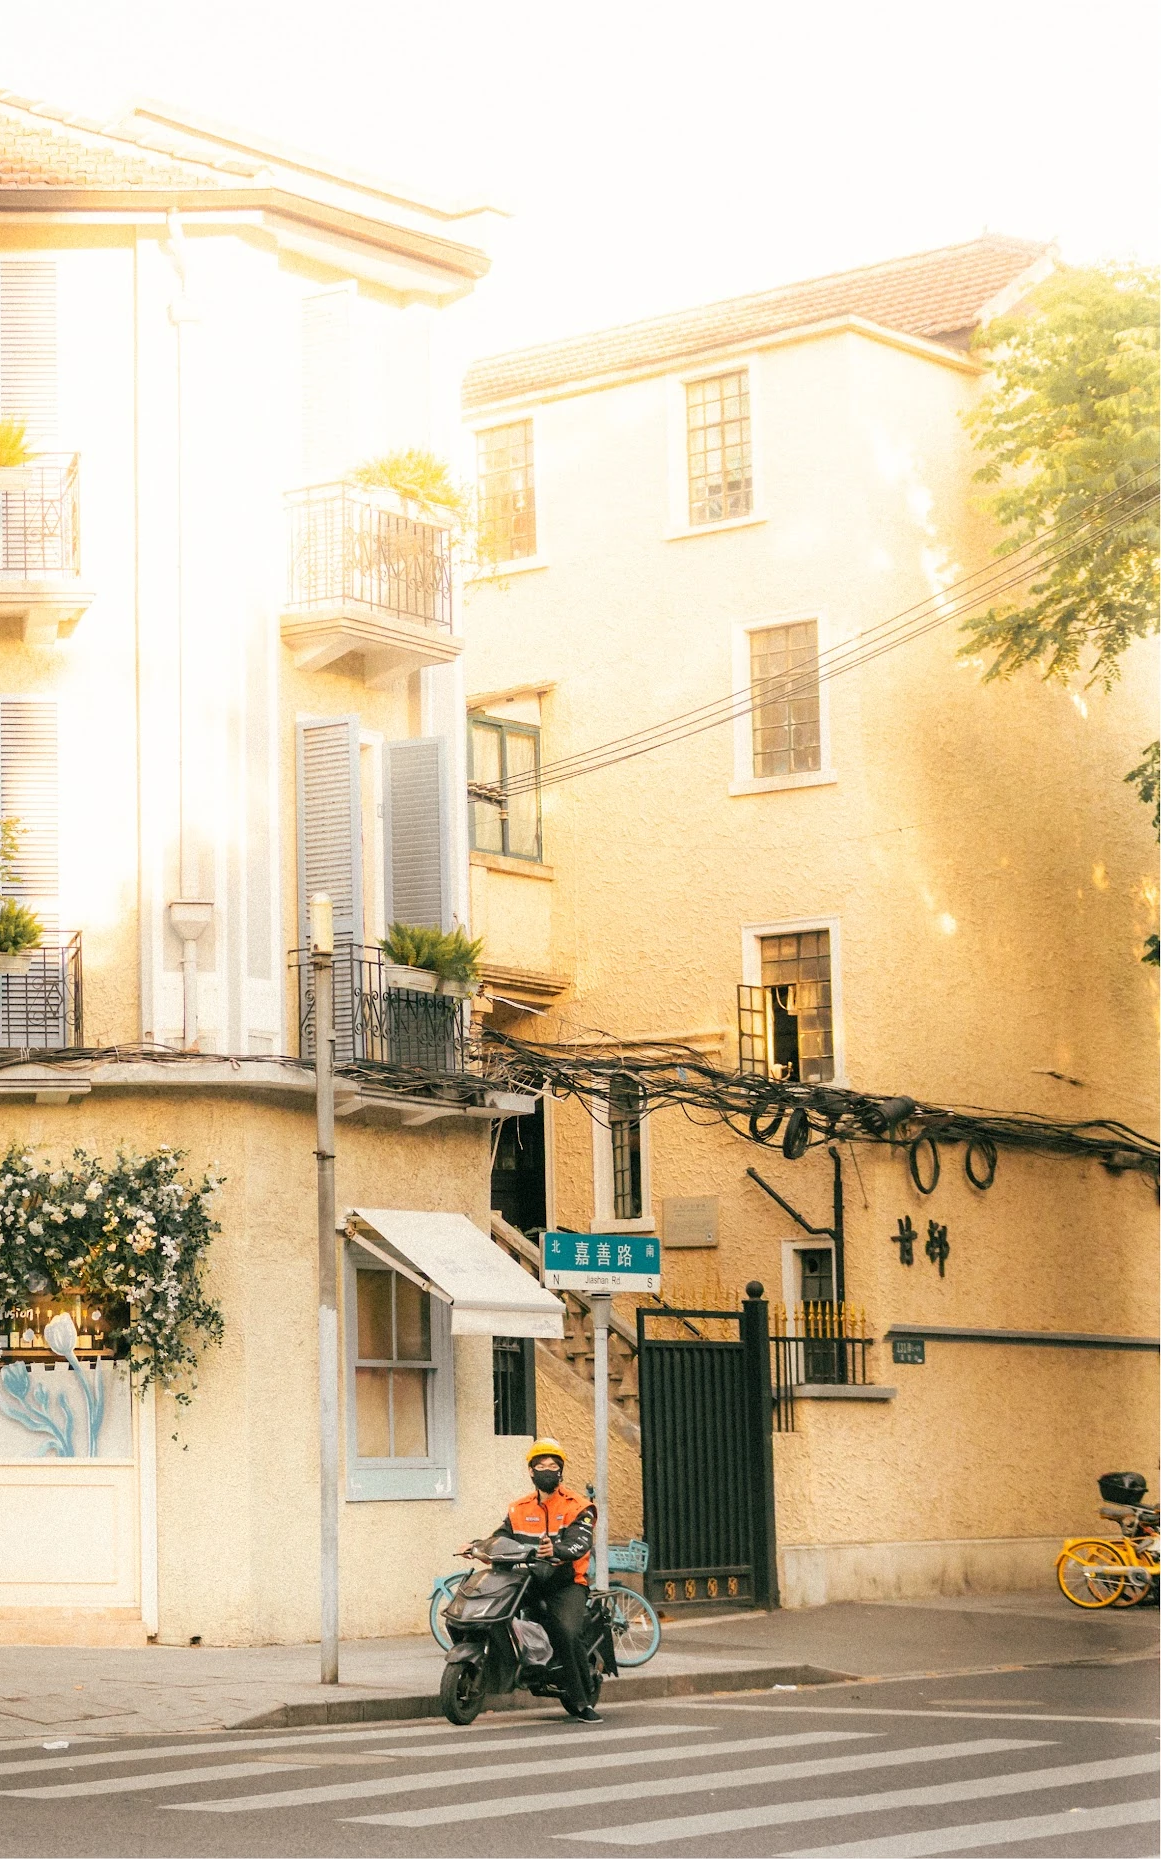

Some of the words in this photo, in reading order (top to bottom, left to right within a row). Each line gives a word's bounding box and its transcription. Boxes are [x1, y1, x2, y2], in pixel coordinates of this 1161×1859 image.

[551, 1239, 561, 1254] 北
[574, 1241, 633, 1267] 嘉善路
[645, 1244, 655, 1258] 南
[553, 1274, 560, 1285] N
[585, 1275, 609, 1284] Jiashan
[611, 1276, 621, 1285] Rd
[647, 1277, 653, 1288] S
